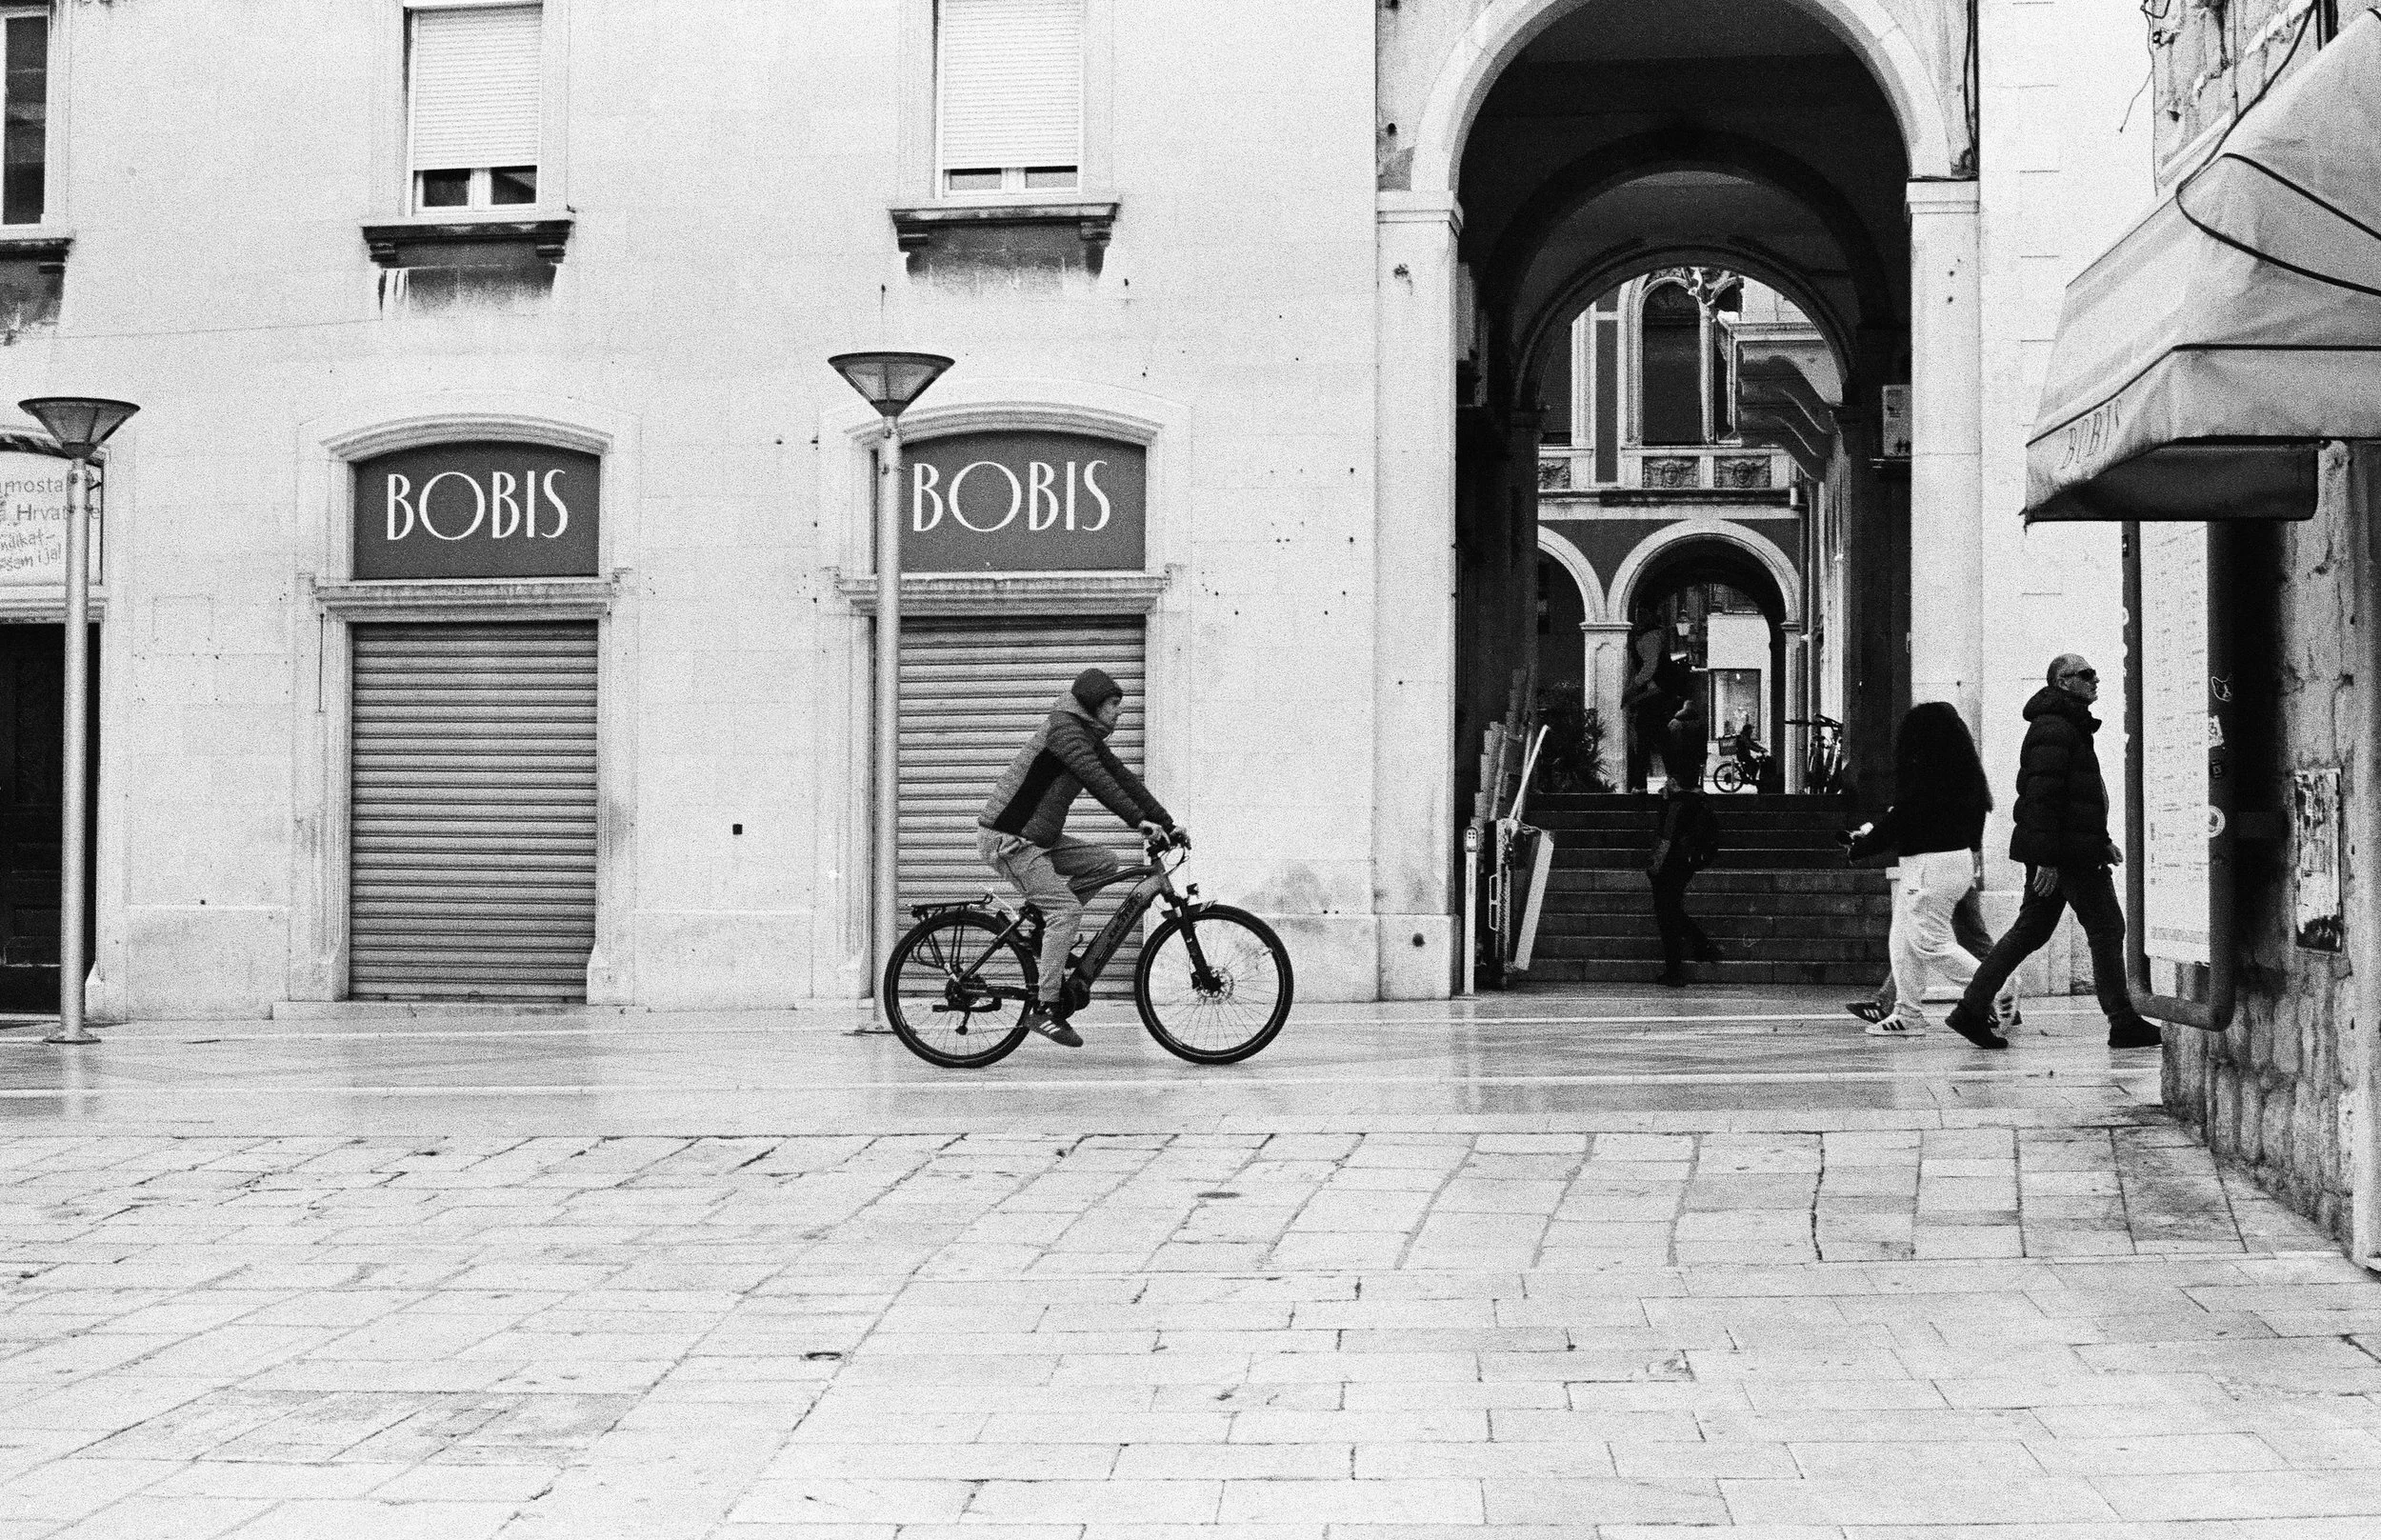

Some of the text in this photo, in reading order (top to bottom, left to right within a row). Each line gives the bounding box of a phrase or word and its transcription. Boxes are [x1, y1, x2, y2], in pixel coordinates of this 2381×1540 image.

[4, 477, 63, 493] mosta
[387, 469, 569, 540] BOBIS
[913, 460, 1110, 532] BOBIS
